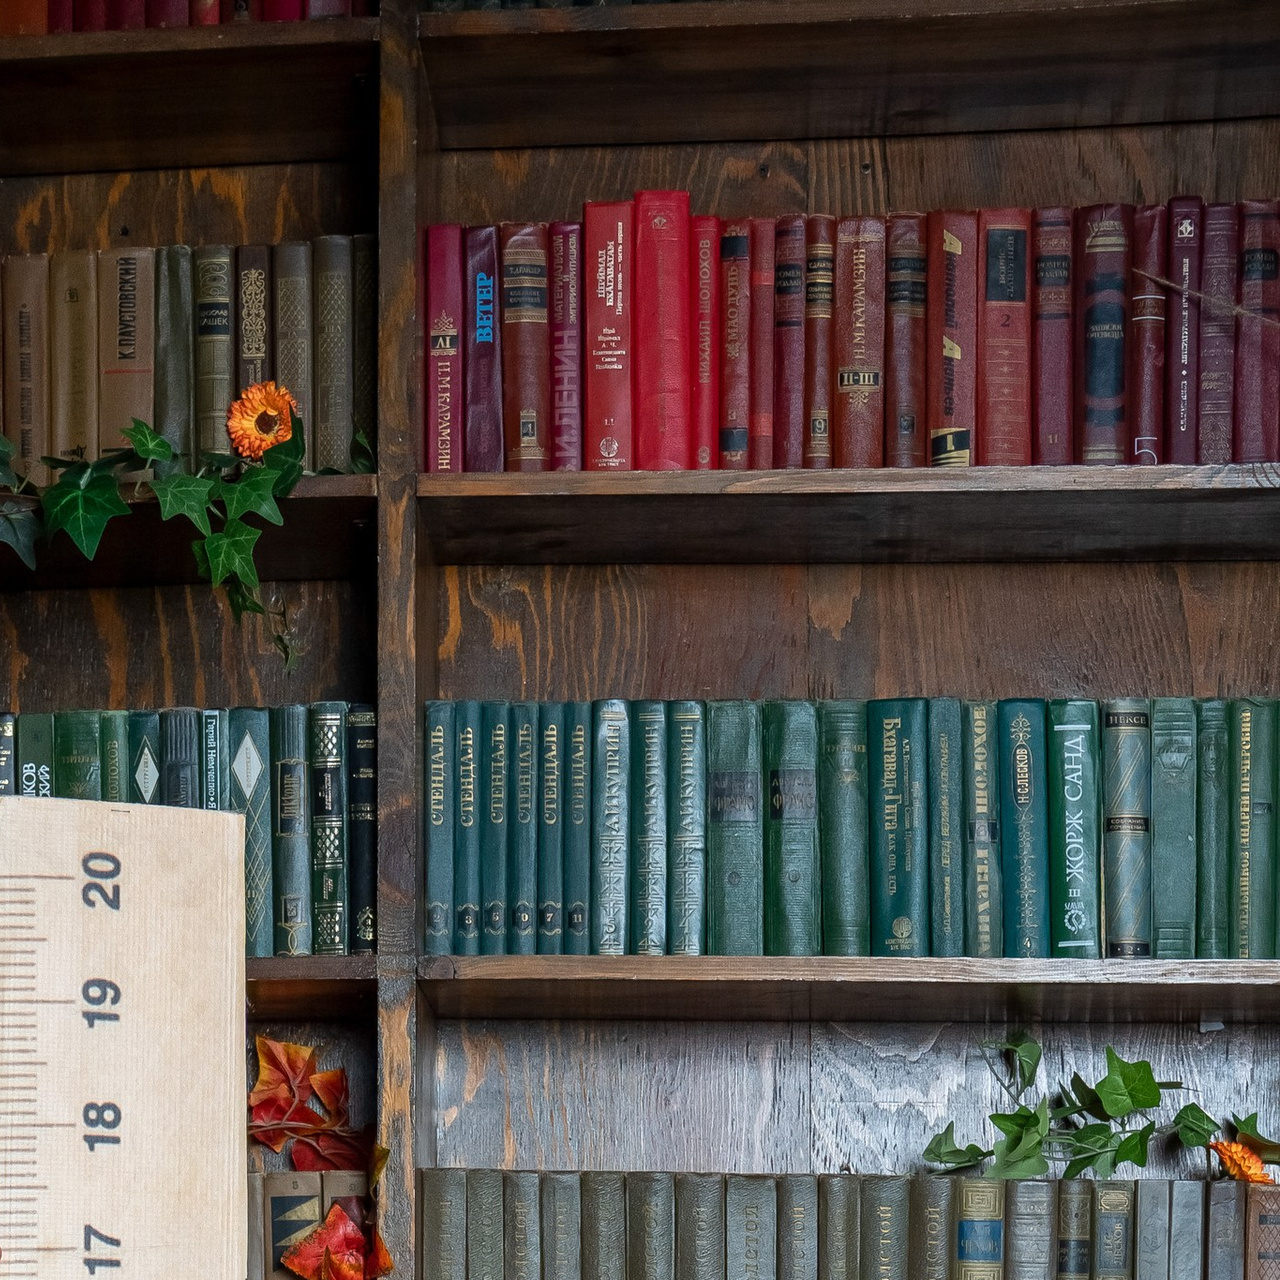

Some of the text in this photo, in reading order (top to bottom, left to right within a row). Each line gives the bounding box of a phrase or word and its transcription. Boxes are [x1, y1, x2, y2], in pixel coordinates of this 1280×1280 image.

[476, 271, 493, 343] ВЕТЕР
[552, 234, 564, 324] МАТЕРИАЛИЗМ
[699, 239, 711, 384] МИХАИЛ ШОЛОХОВ
[1000, 313, 1011, 328] 2
[816, 419, 825, 434] 9
[1109, 715, 1147, 725] НЕКСЕ
[430, 725, 444, 826] СТЕНДАЛЬ
[460, 727, 474, 827] СТЕНДАЛЬ
[490, 723, 505, 824] СТЕНДАЛЬ
[544, 724, 557, 825] СТЕНДАЛЬ
[882, 718, 902, 832] Бхагавад-Гита
[1064, 734, 1085, 883] ЖОРЖ САНД
[83, 852, 121, 910] 20
[83, 979, 121, 1028] 19
[83, 1103, 122, 1152] 18
[83, 1225, 121, 1275] 17
